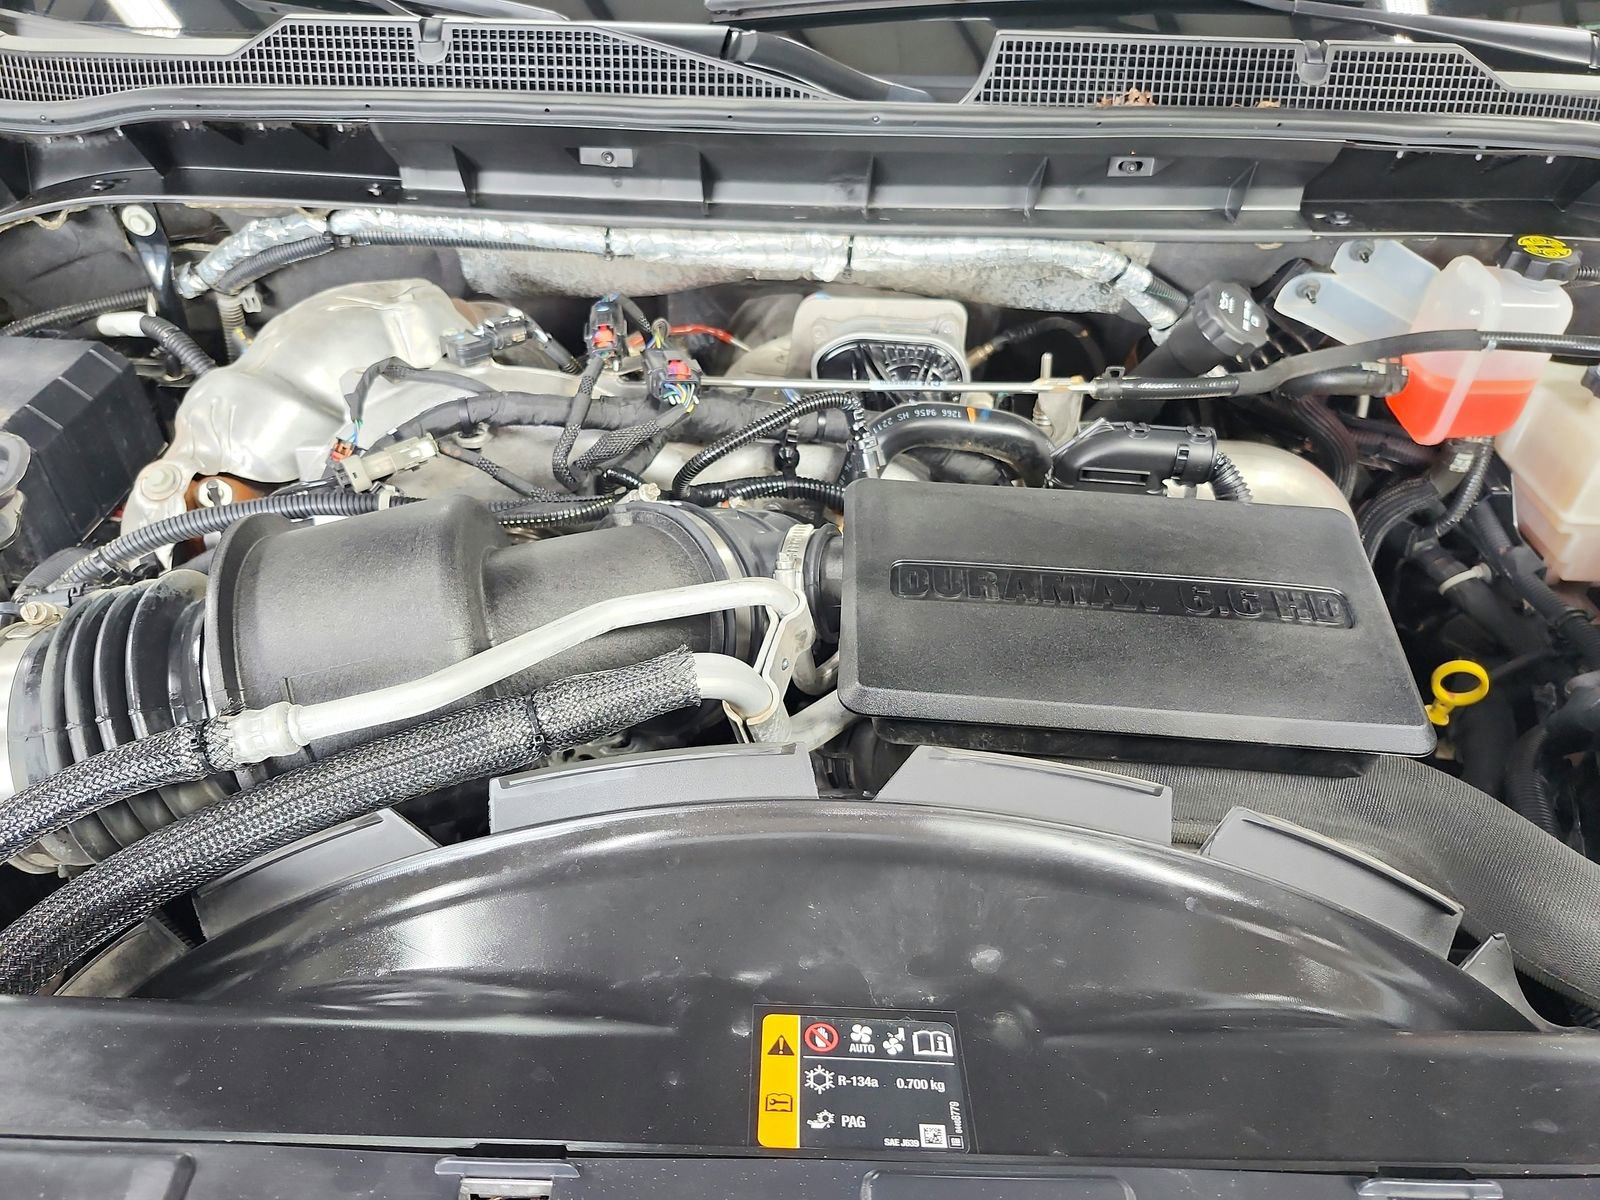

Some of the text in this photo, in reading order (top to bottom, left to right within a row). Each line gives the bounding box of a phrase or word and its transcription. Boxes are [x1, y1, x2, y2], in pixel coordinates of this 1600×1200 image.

[896, 412, 910, 422] HS
[914, 408, 937, 418] 9456
[941, 409, 962, 418] 1266
[897, 566, 1343, 625] DURAMAX 6.6 HD
[849, 1043, 876, 1054] AUTO
[838, 1073, 946, 1093] R-134a 0.700 kg
[841, 1115, 867, 1129] PAG
[884, 1137, 920, 1148] SAE J639
